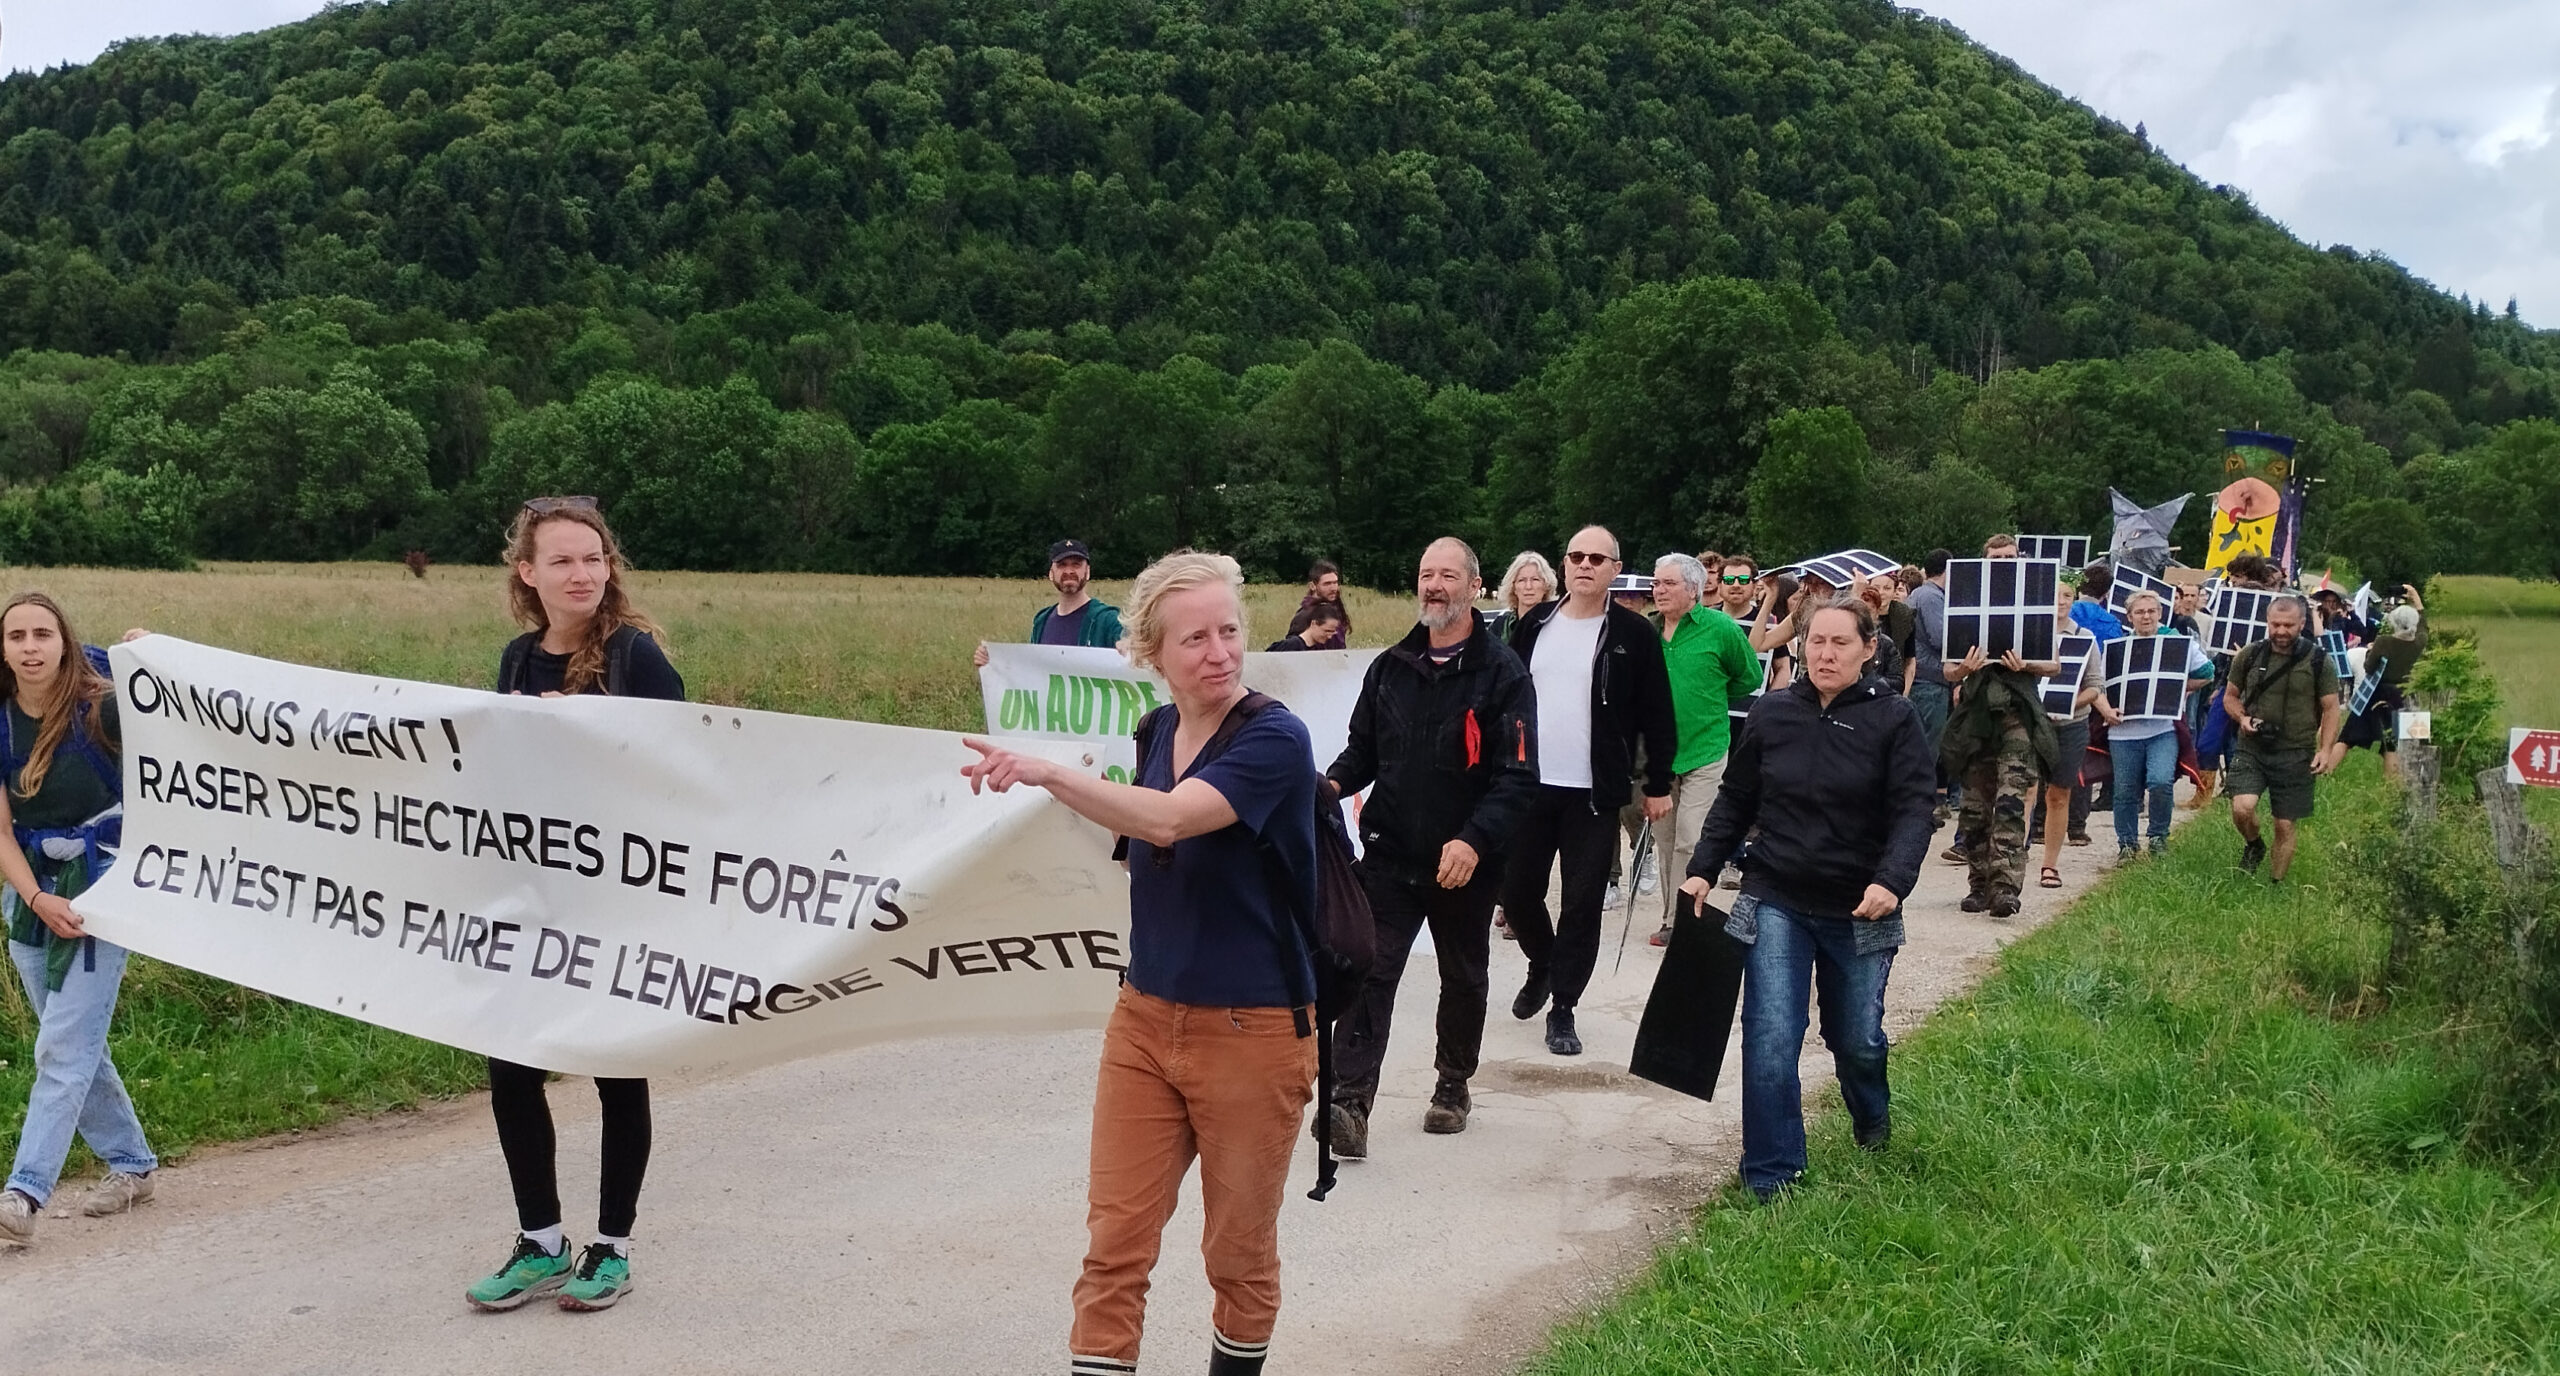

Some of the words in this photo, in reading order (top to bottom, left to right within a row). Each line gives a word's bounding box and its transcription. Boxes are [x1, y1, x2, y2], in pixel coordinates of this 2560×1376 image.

[128, 667, 188, 722] ON
[189, 683, 301, 748] NOUS
[310, 707, 426, 764] MENT
[440, 718, 462, 772] !
[1000, 689, 1040, 731] UN
[138, 755, 271, 819] RASER
[278, 778, 360, 836] DES
[373, 791, 604, 878] HECTARES
[620, 832, 690, 897] DE
[709, 848, 909, 932] FORÊTS
[133, 844, 189, 895] CE
[194, 847, 306, 919] N'EST
[313, 877, 385, 939] PAS
[398, 901, 522, 974] FAIRE
[530, 928, 601, 990] DE
[609, 942, 885, 1025] L'ENERGIE
[890, 930, 1128, 980] VERTE
